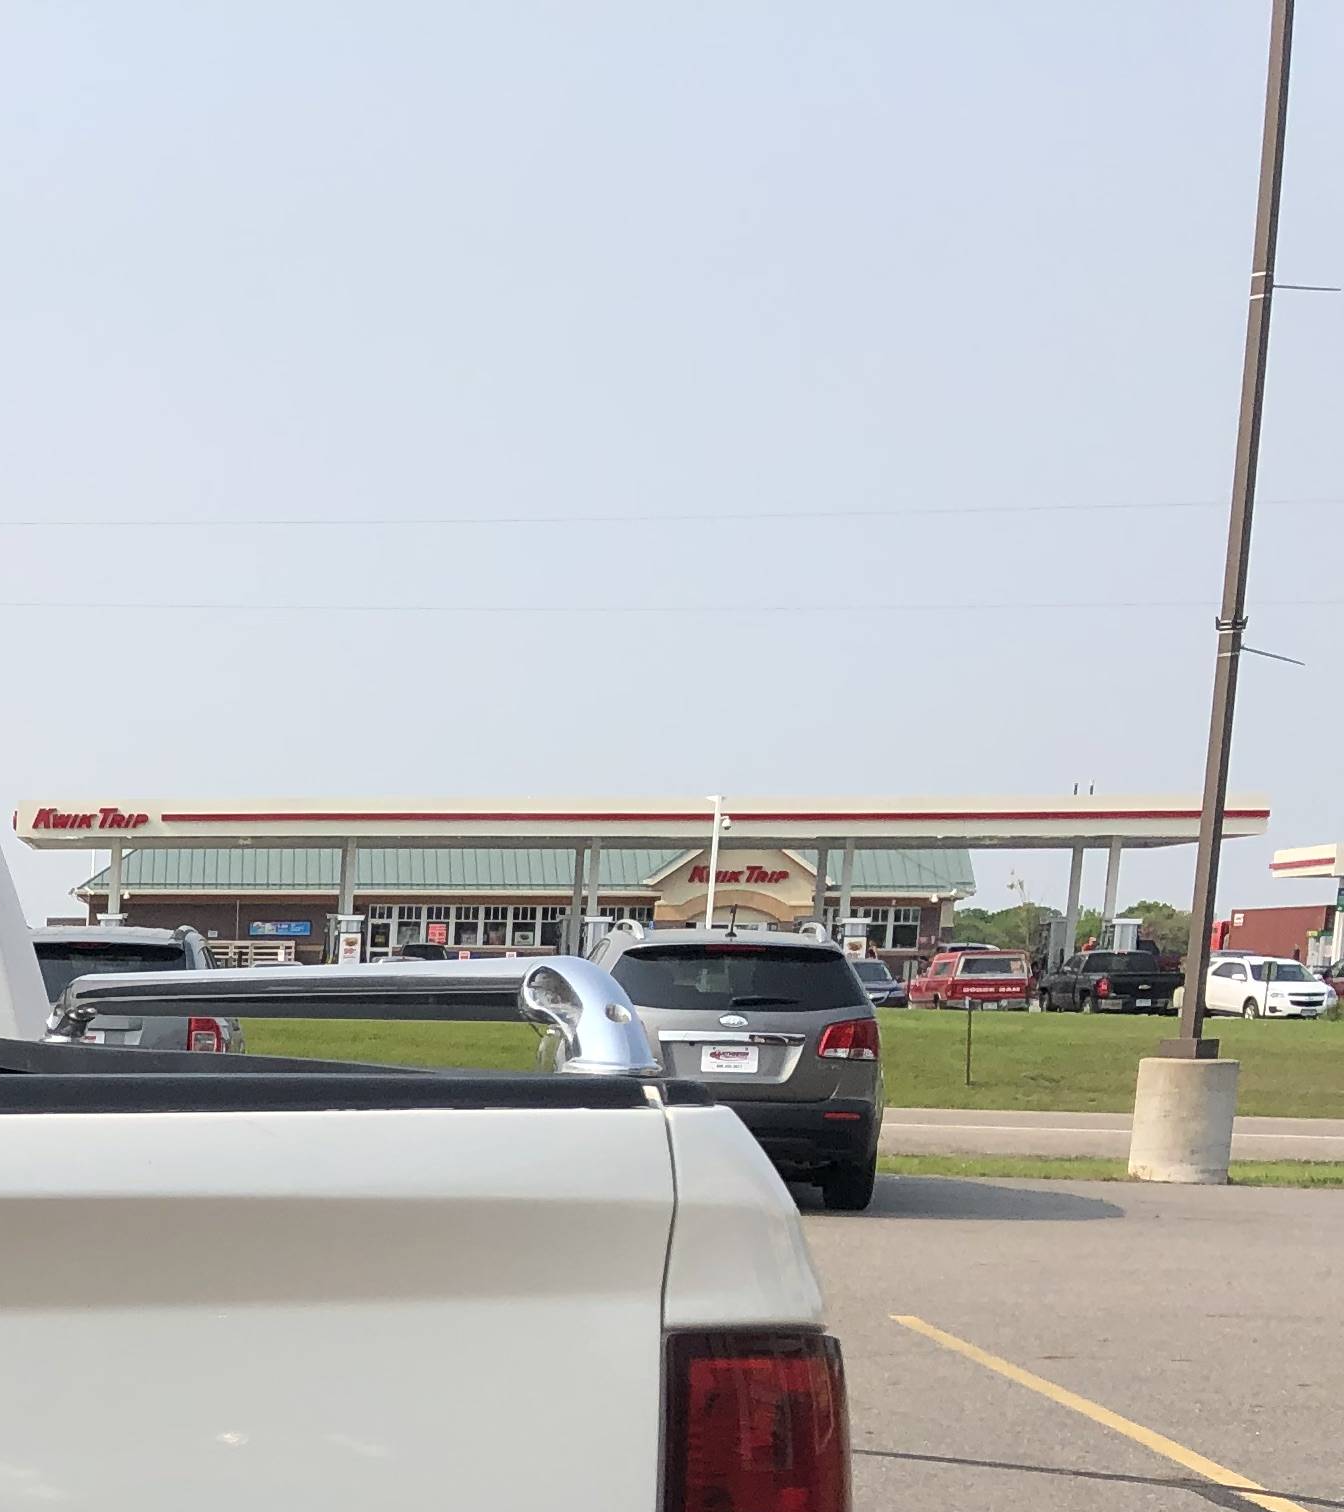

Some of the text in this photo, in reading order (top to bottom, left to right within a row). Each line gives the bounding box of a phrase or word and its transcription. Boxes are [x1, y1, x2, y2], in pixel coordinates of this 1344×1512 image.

[32, 808, 149, 829] KWIK TRIP
[745, 865, 789, 883] TRIP
